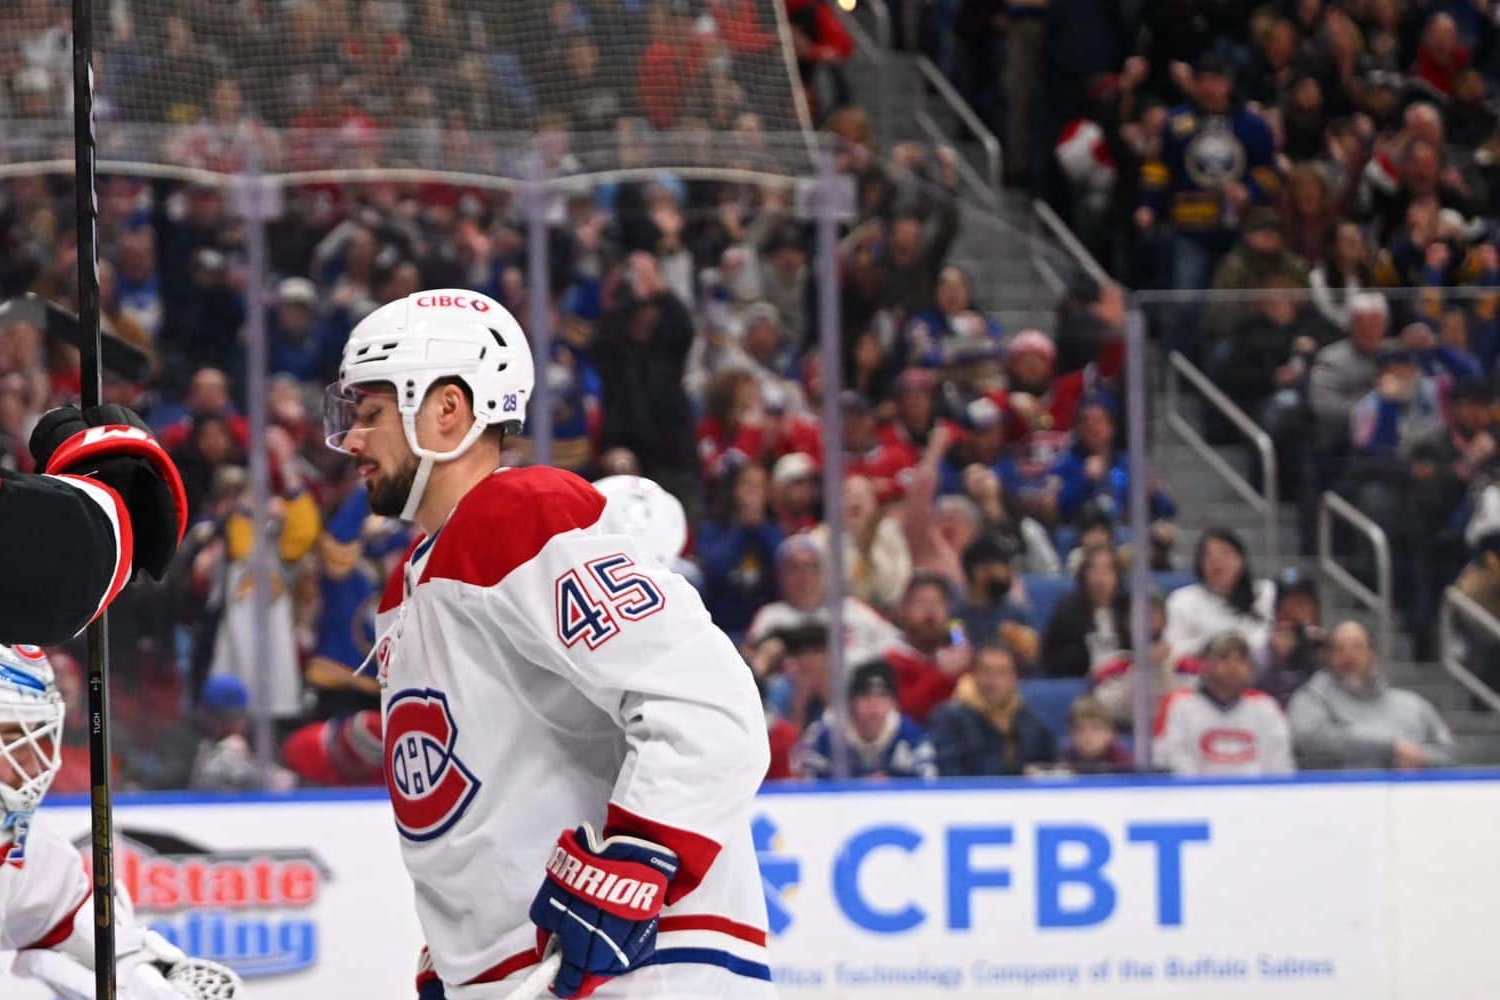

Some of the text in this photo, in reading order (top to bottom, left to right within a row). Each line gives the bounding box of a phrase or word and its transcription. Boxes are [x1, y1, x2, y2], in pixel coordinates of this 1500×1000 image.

[416, 295, 468, 309] CIBC
[502, 393, 517, 412] 29
[555, 553, 665, 651] 45
[93, 711, 101, 735] TUCH
[547, 846, 659, 911] ARRIOR
[830, 818, 1212, 936] CFBT
